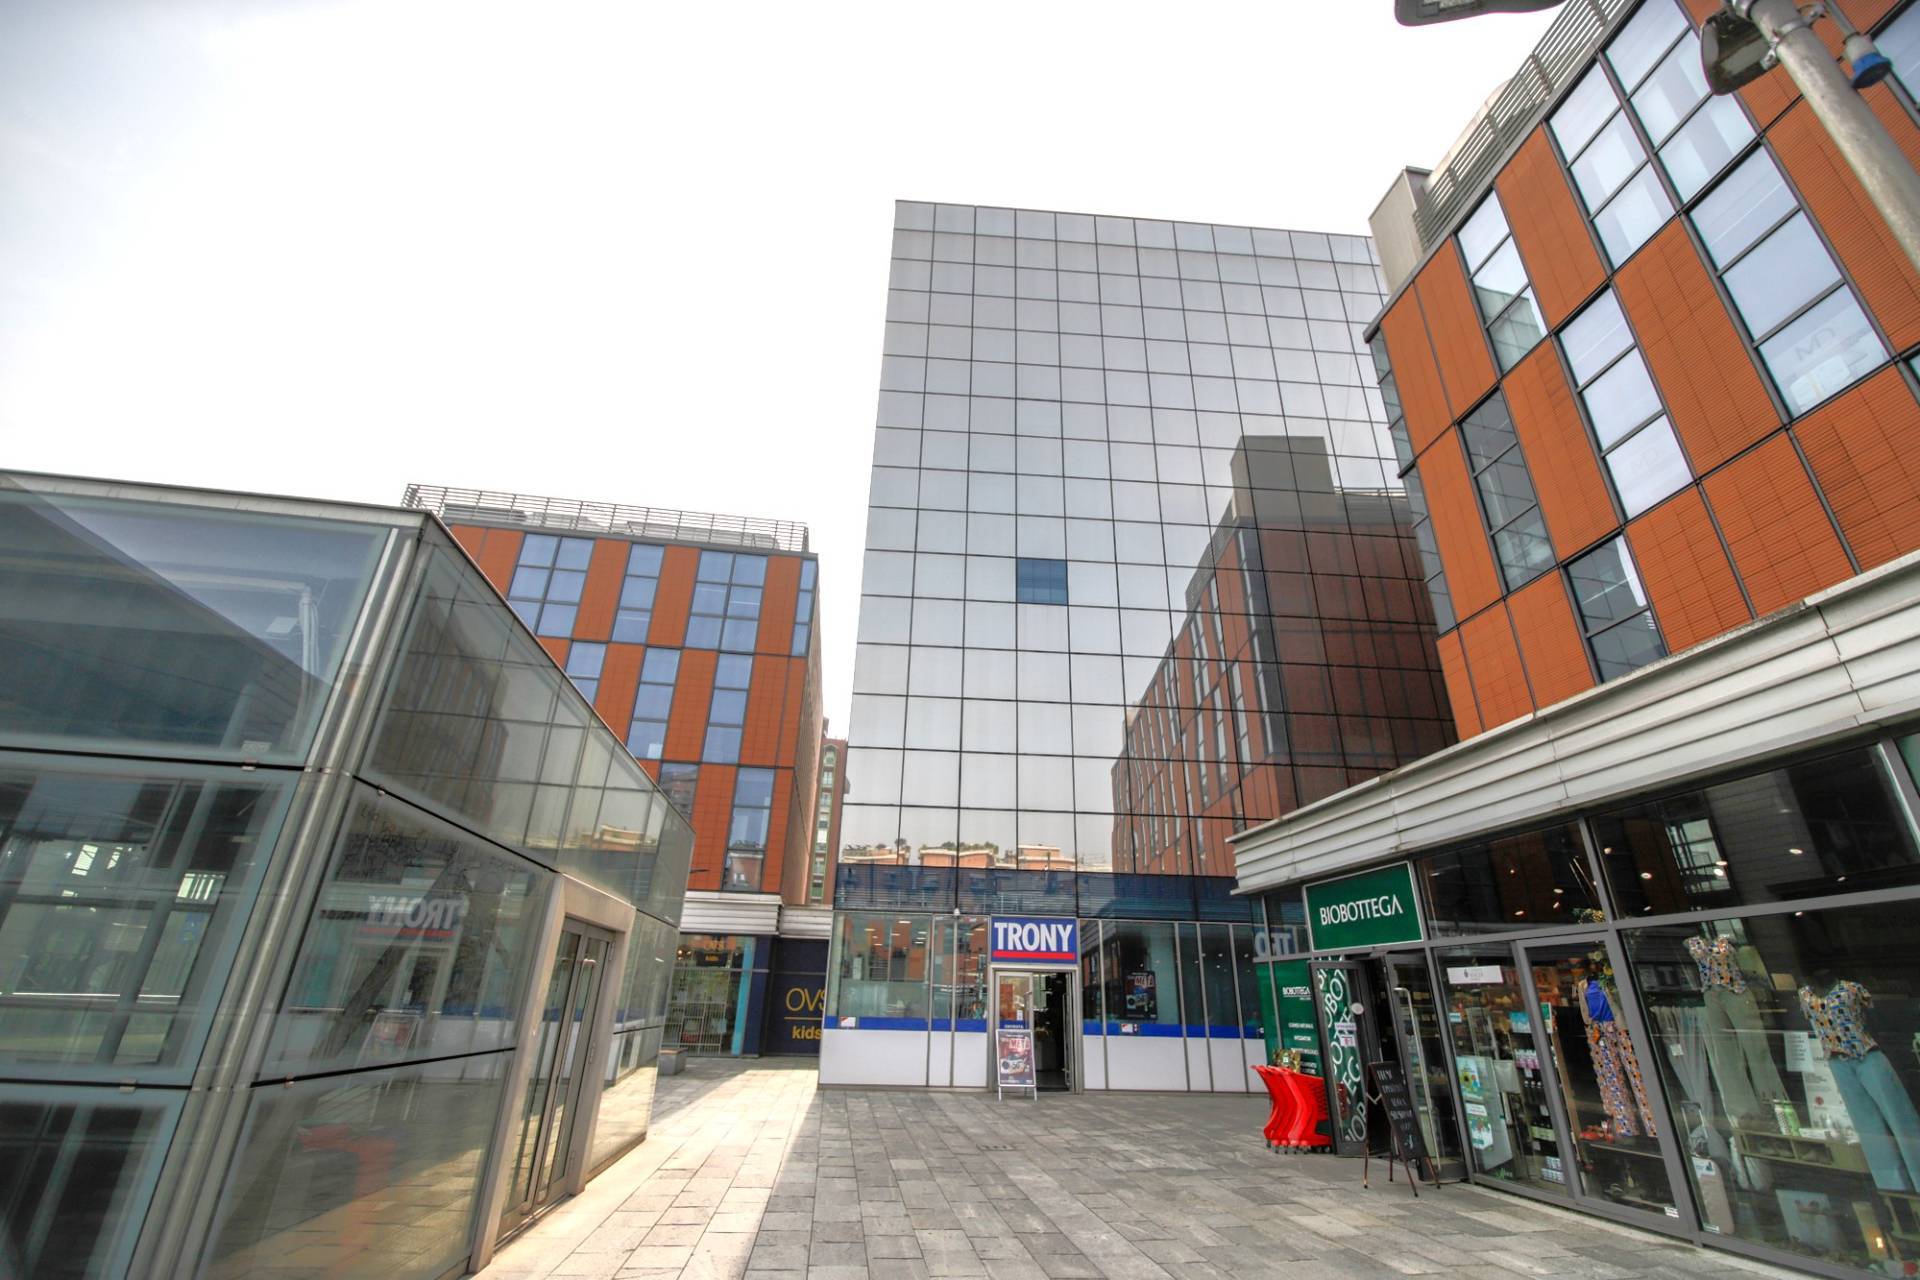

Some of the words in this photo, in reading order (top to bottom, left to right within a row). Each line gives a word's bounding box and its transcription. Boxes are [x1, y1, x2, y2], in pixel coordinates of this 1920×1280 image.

[1319, 894, 1403, 926] BIOBOTTEGA
[993, 921, 1073, 952] TRONY
[792, 1025, 822, 1040] kids
